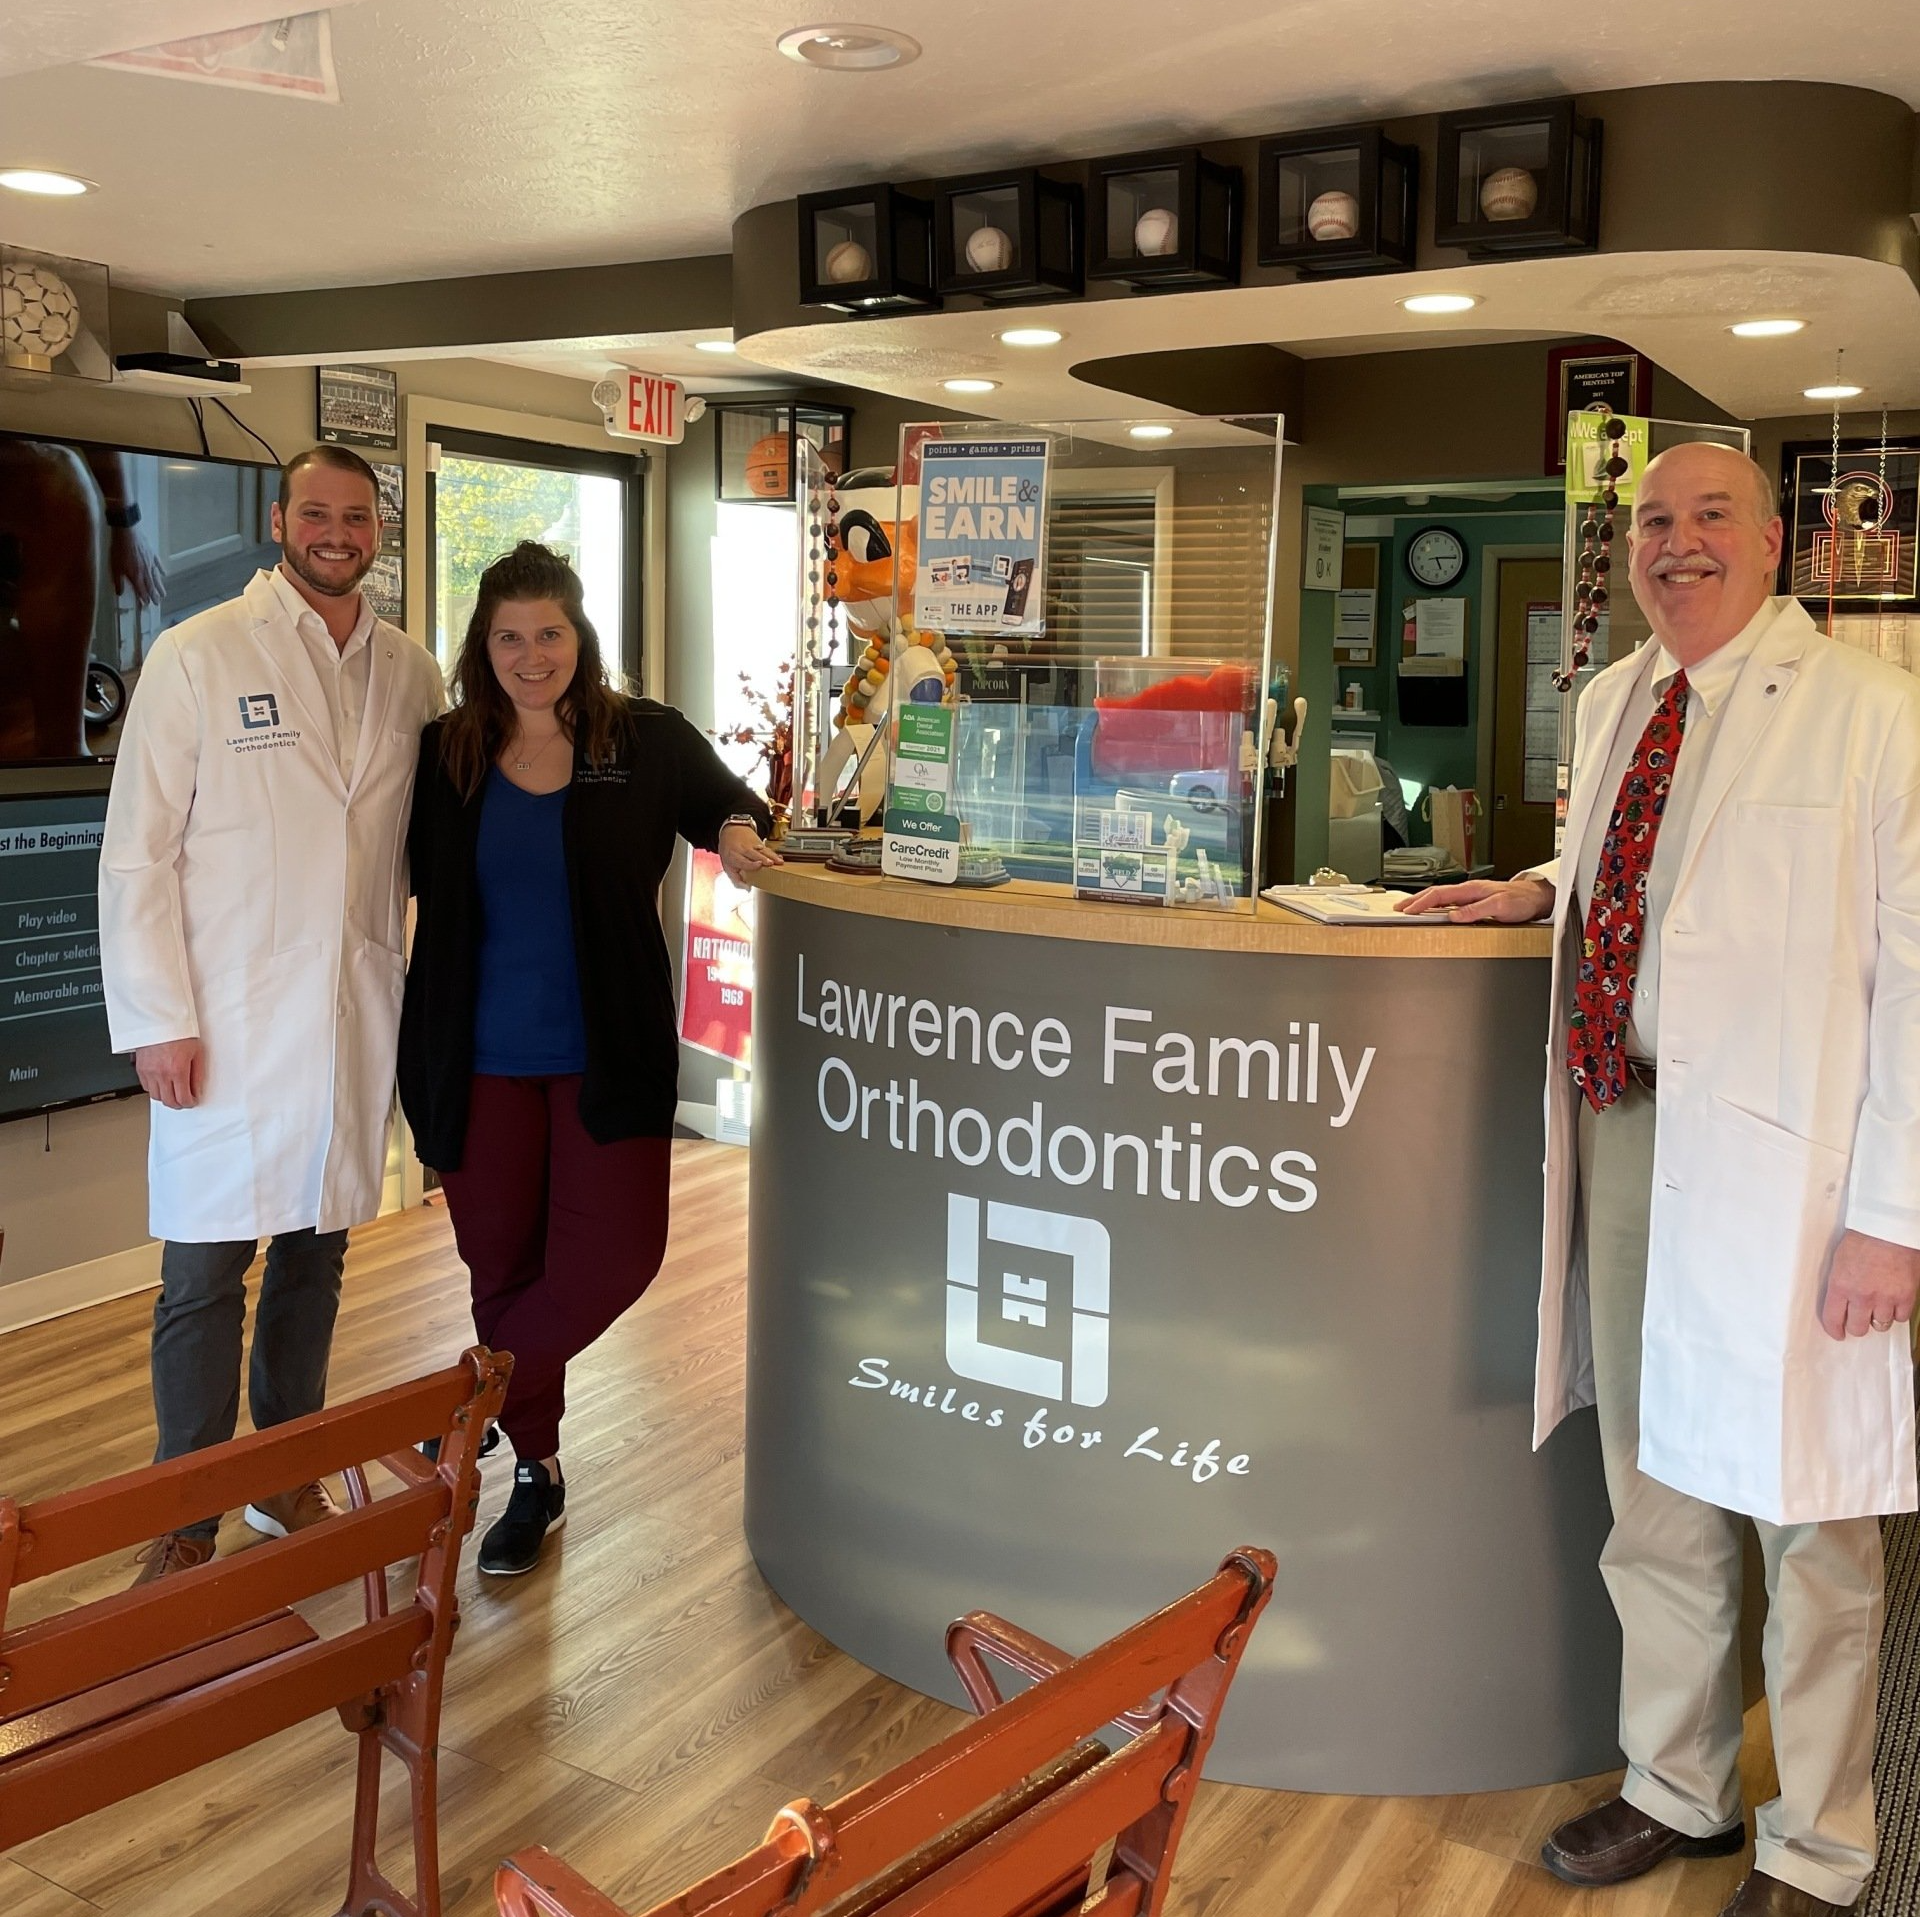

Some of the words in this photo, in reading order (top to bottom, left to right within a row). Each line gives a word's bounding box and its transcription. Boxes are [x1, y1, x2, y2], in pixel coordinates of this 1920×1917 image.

[1574, 372, 1610, 380] AMERICA'S
[629, 375, 676, 437] EXIT
[928, 446, 958, 456] points
[968, 446, 999, 455] games
[1010, 444, 1042, 454] prizes
[925, 505, 1036, 540] EARN
[950, 603, 971, 615] THE
[975, 603, 998, 616] APP
[226, 734, 270, 745] Lawrence
[235, 740, 296, 753] Orthodontics
[902, 819, 917, 829] We
[919, 821, 942, 833] Offer
[15, 833, 36, 850] the
[40, 830, 104, 850] Beginning
[889, 841, 950, 860] CareCredit
[895, 861, 924, 871] Payment
[924, 864, 943, 873] Plans
[899, 856, 913, 864] Low
[914, 857, 940, 867] Monthly
[1112, 868, 1131, 876] FIELD
[18, 913, 43, 929] Play
[46, 908, 77, 924] video
[16, 951, 60, 967] Chapter
[14, 981, 79, 1005] Memorable
[721, 988, 743, 1006] 1968
[797, 953, 1072, 1077] Lawrence
[1103, 1005, 1376, 1128] Family
[9, 1066, 38, 1082] Main
[817, 1056, 1318, 1212] Orthodontics
[848, 1358, 1004, 1427] Smiles
[1023, 1408, 1102, 1448] for
[1123, 1426, 1250, 1483] Life
